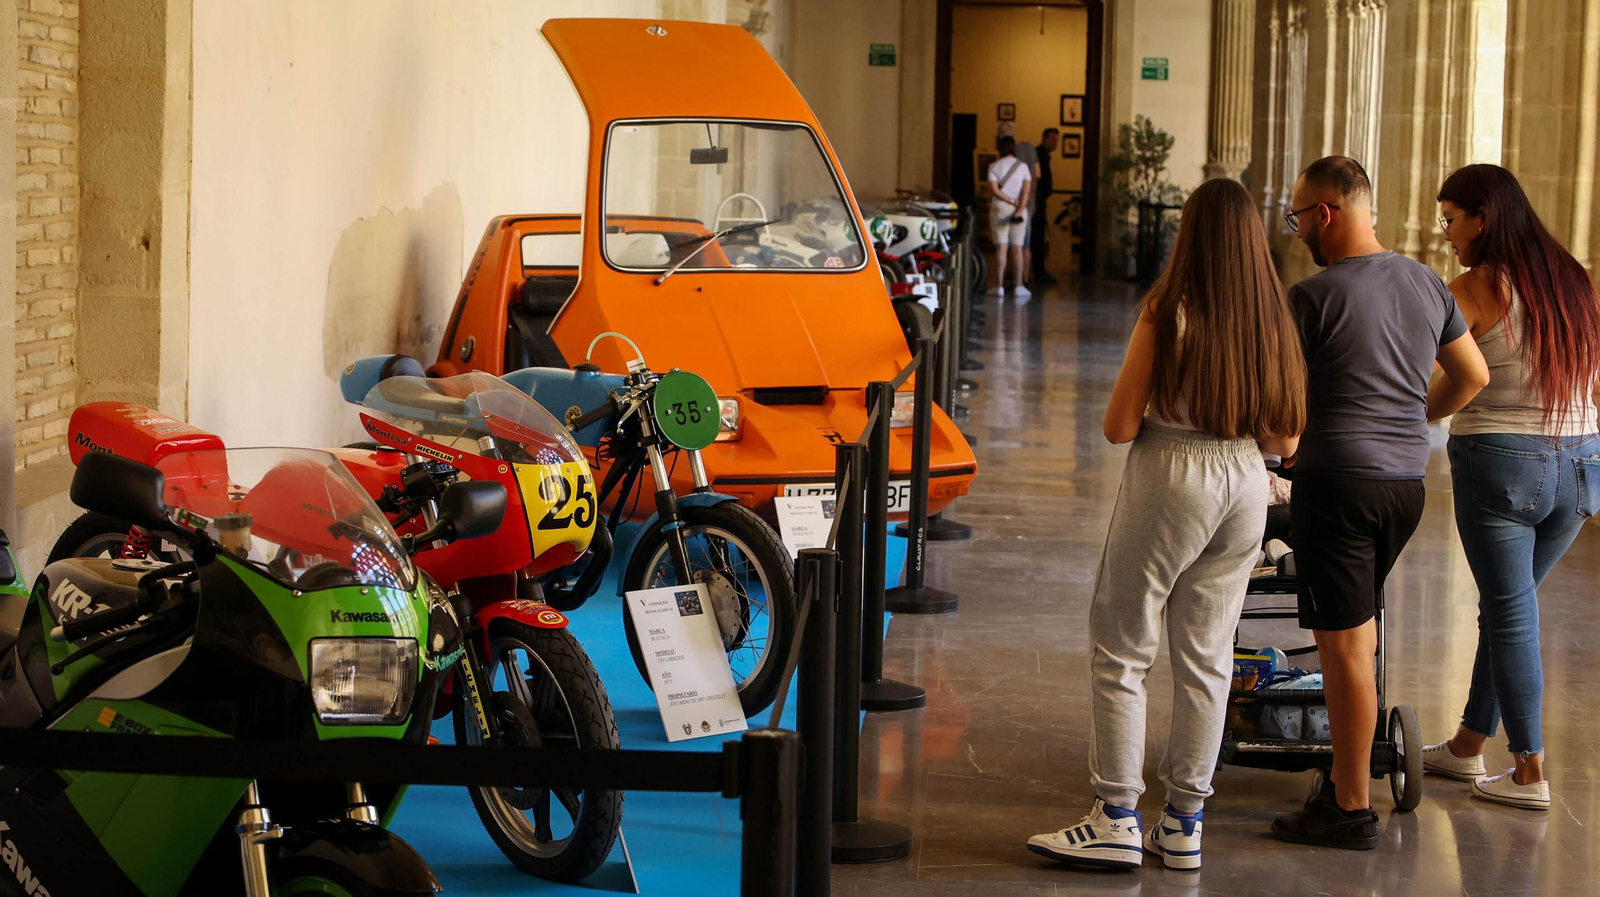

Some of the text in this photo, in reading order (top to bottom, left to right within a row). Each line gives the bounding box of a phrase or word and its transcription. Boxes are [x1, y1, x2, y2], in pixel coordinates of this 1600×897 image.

[672, 401, 702, 426] 35
[74, 432, 120, 456] Mont
[366, 424, 407, 445] Montesa
[416, 445, 453, 461] MICHELIN
[537, 475, 597, 530] 25
[330, 610, 399, 623] Kawasa
[668, 691, 698, 699] PROPIETARIO
